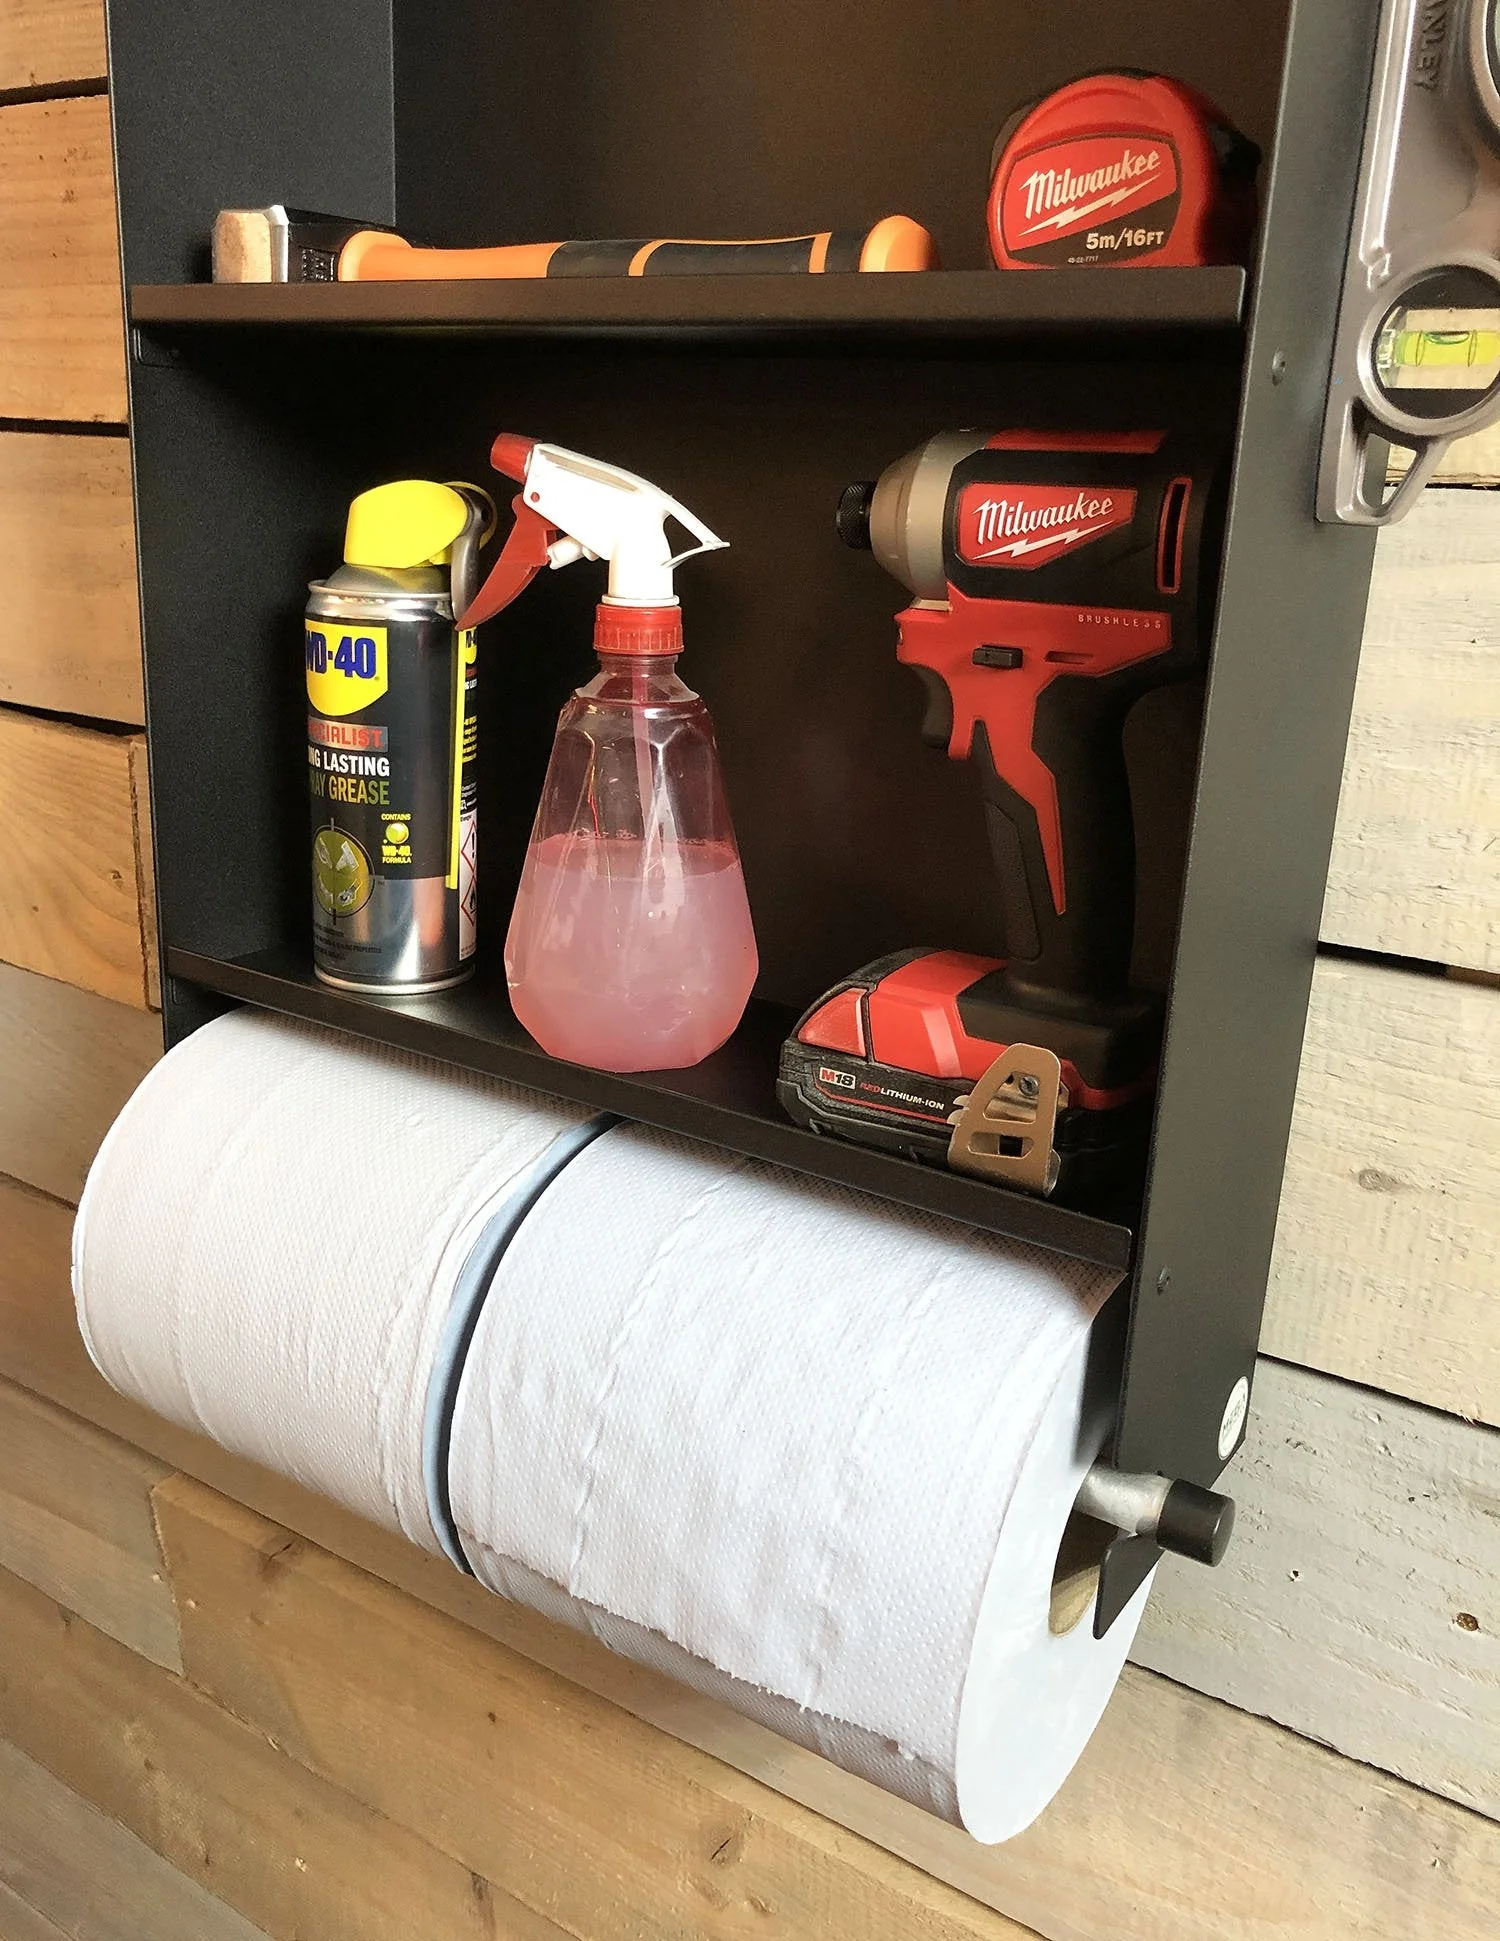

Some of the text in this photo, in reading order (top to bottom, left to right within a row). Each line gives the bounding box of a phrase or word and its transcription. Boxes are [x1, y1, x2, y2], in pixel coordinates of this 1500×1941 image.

[1019, 149, 1162, 220] Milwaukee
[1086, 227, 1164, 250] 5m/16FT
[972, 492, 1114, 545] Milwaukee
[1078, 613, 1161, 630] BRUSHLESS
[323, 751, 390, 777] LASTING
[328, 775, 390, 805] GREASE
[381, 813, 411, 821] CONTAINS
[821, 1068, 854, 1088] M18
